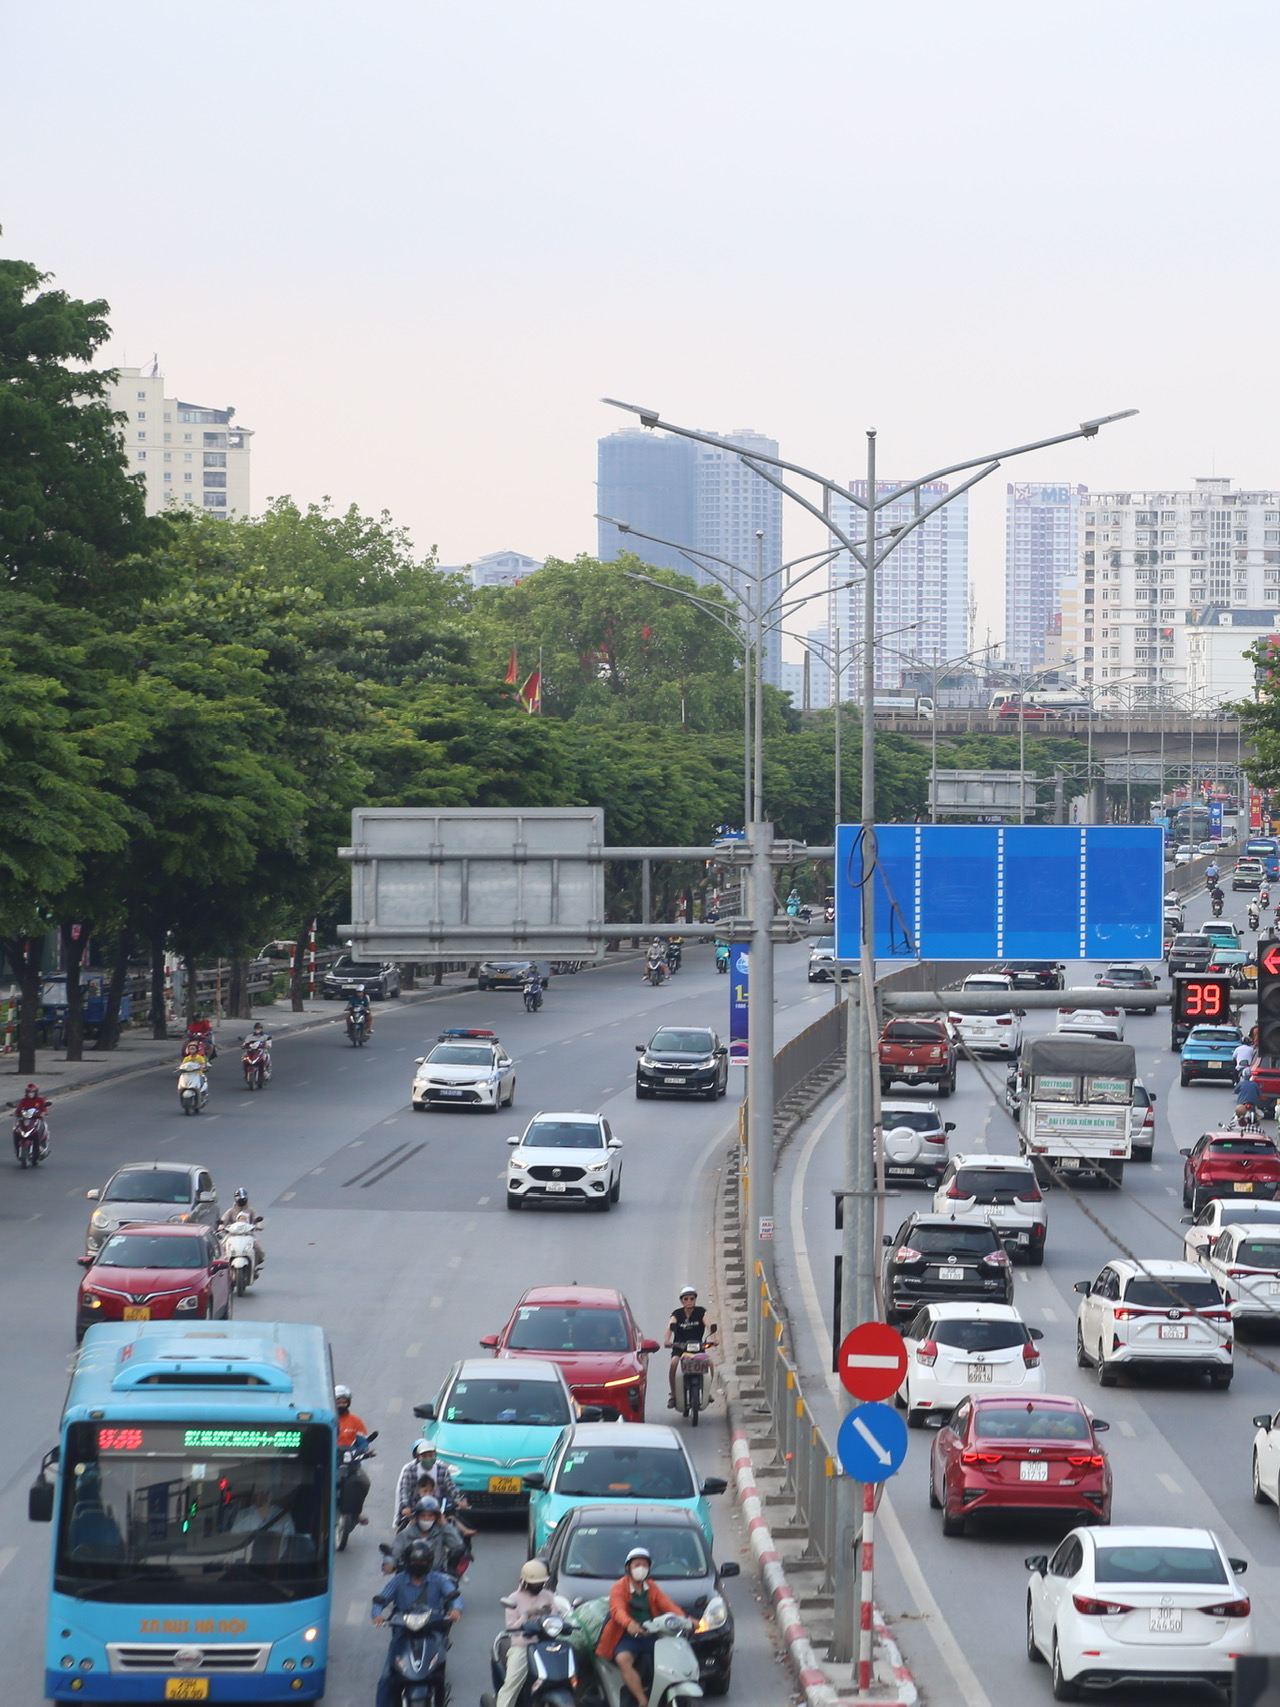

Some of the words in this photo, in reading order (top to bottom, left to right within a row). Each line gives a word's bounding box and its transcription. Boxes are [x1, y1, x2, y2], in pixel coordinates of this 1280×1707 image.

[1041, 487, 1070, 502] MB
[1186, 984, 1220, 1016] 39
[1158, 1608, 1173, 1619] 30F
[1150, 1620, 1182, 1632] 244.50
